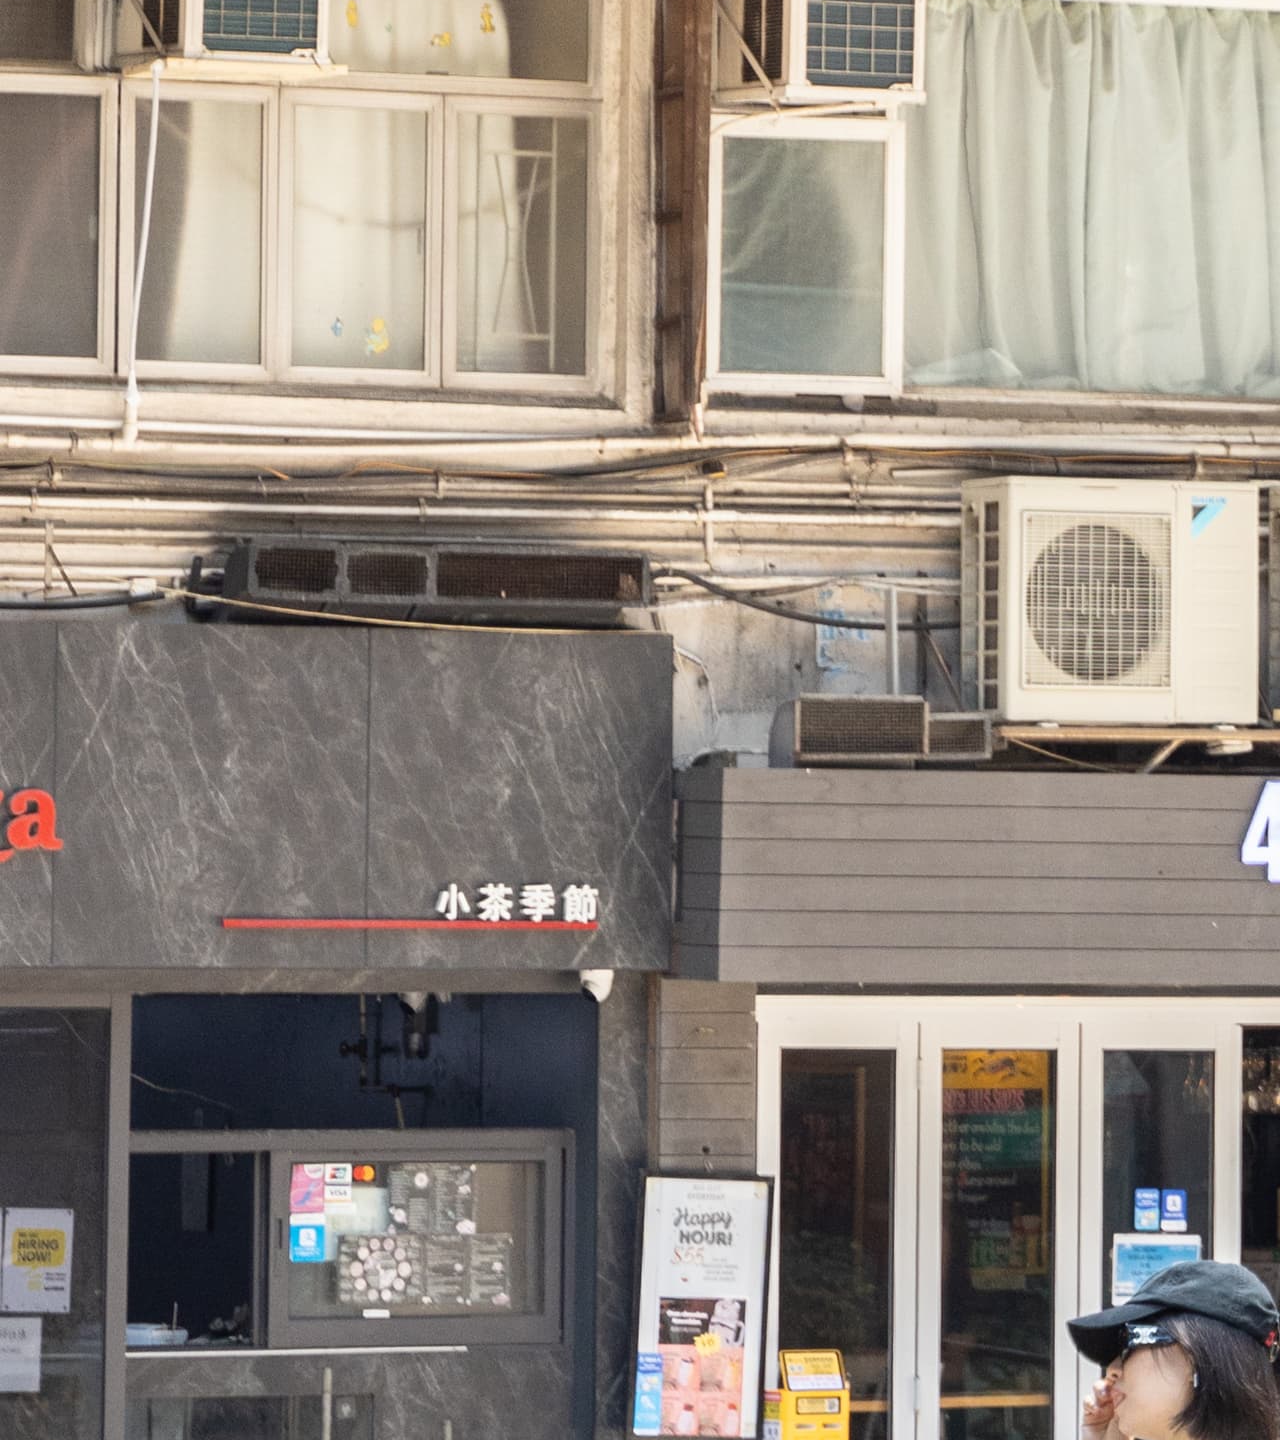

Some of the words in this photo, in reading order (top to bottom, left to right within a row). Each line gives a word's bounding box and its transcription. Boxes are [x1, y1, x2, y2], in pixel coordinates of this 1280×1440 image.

[435, 882, 600, 924] 小茶季節
[673, 1207, 732, 1231] Happy
[17, 1239, 60, 1251] HIRING
